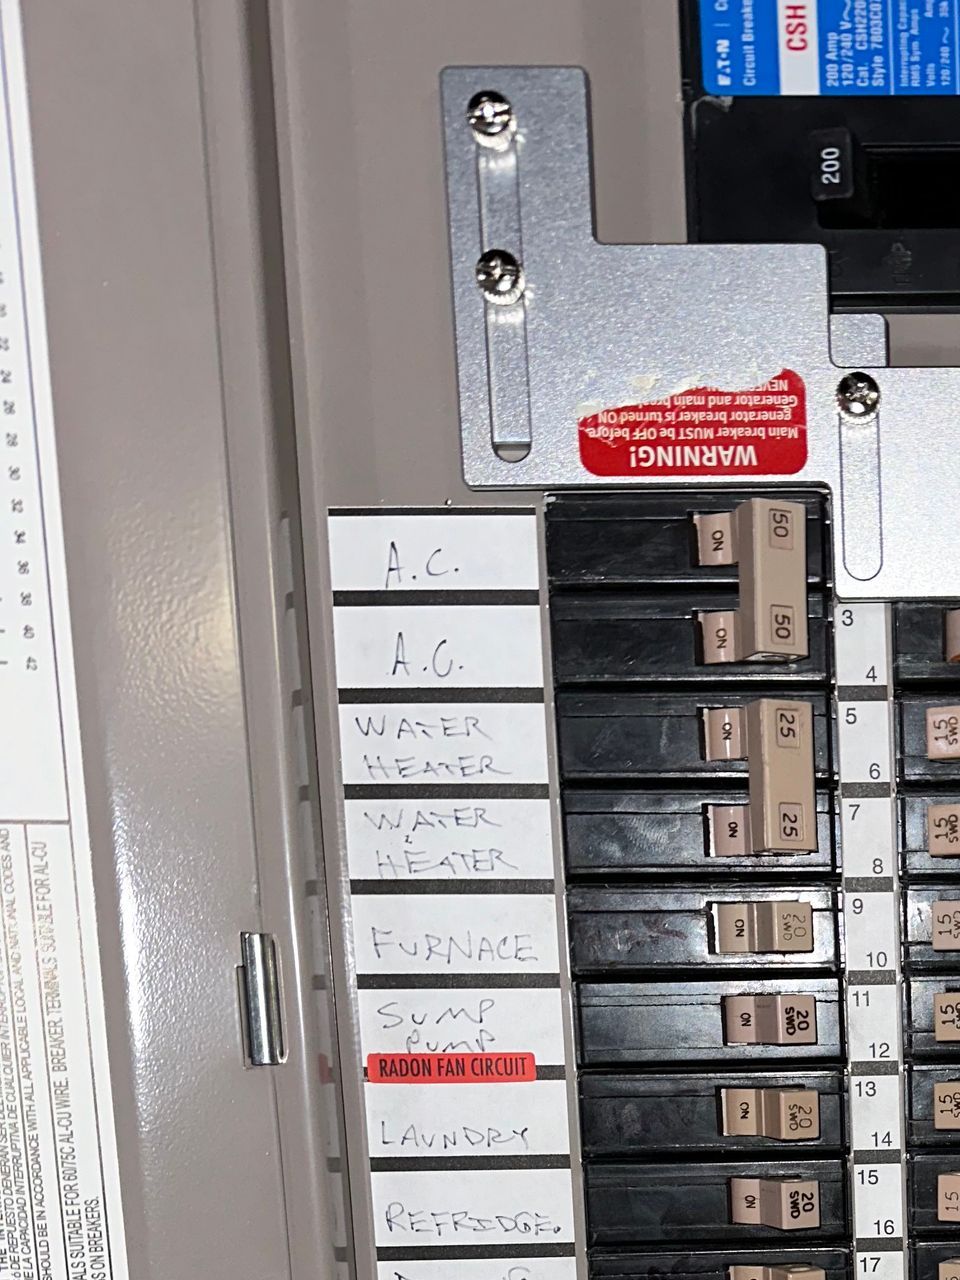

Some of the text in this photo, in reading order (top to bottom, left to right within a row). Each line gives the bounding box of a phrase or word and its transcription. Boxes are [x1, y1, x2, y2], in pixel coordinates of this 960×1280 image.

[785, 5, 808, 51] CSH
[742, 45, 757, 86] Circuit
[826, 32, 840, 87] 200 Amp
[872, 55, 886, 87] Style
[820, 147, 840, 185] 200
[673, 395, 705, 407] main
[708, 394, 731, 407] and
[598, 409, 792, 424] generator breaker is turned ON
[633, 428, 657, 440] OFF
[659, 427, 676, 440] be
[678, 427, 714, 440] MUST
[716, 426, 767, 439] breaker
[768, 426, 798, 439] Main
[629, 445, 758, 468] WARNING!
[772, 511, 790, 538] 50
[711, 529, 725, 552] ON
[773, 613, 791, 640] 50
[841, 609, 854, 627] 3
[715, 627, 728, 649] ON
[865, 665, 878, 682] 4
[779, 713, 796, 739] 25
[845, 707, 857, 725] 5
[355, 714, 494, 742] WATER
[363, 754, 512, 780] HEATER
[869, 762, 881, 780] 6
[363, 806, 502, 832] WATER
[848, 804, 861, 821] 7
[781, 813, 799, 838] 25
[376, 848, 519, 880] HEATER
[872, 858, 884, 875] 8
[852, 898, 864, 915] 9
[371, 926, 539, 964] FURNACE
[866, 951, 888, 968] 10
[376, 999, 496, 1029] SUMP
[785, 1006, 796, 1036] SWD
[794, 1009, 810, 1032] 20
[940, 1003, 956, 1026] 15
[405, 1028, 496, 1053] PUMP
[869, 1042, 890, 1059] 12
[379, 1056, 527, 1078] RADON FAN CIRCUIT
[380, 1120, 530, 1149] LAUNDRY
[871, 1131, 893, 1148] 14
[857, 1169, 879, 1185] 15
[789, 1190, 801, 1219] SWD
[800, 1191, 815, 1213] 20
[84, 1195, 104, 1254] BREAKERS.
[873, 1219, 895, 1235] 16
[859, 1257, 881, 1273] 17
